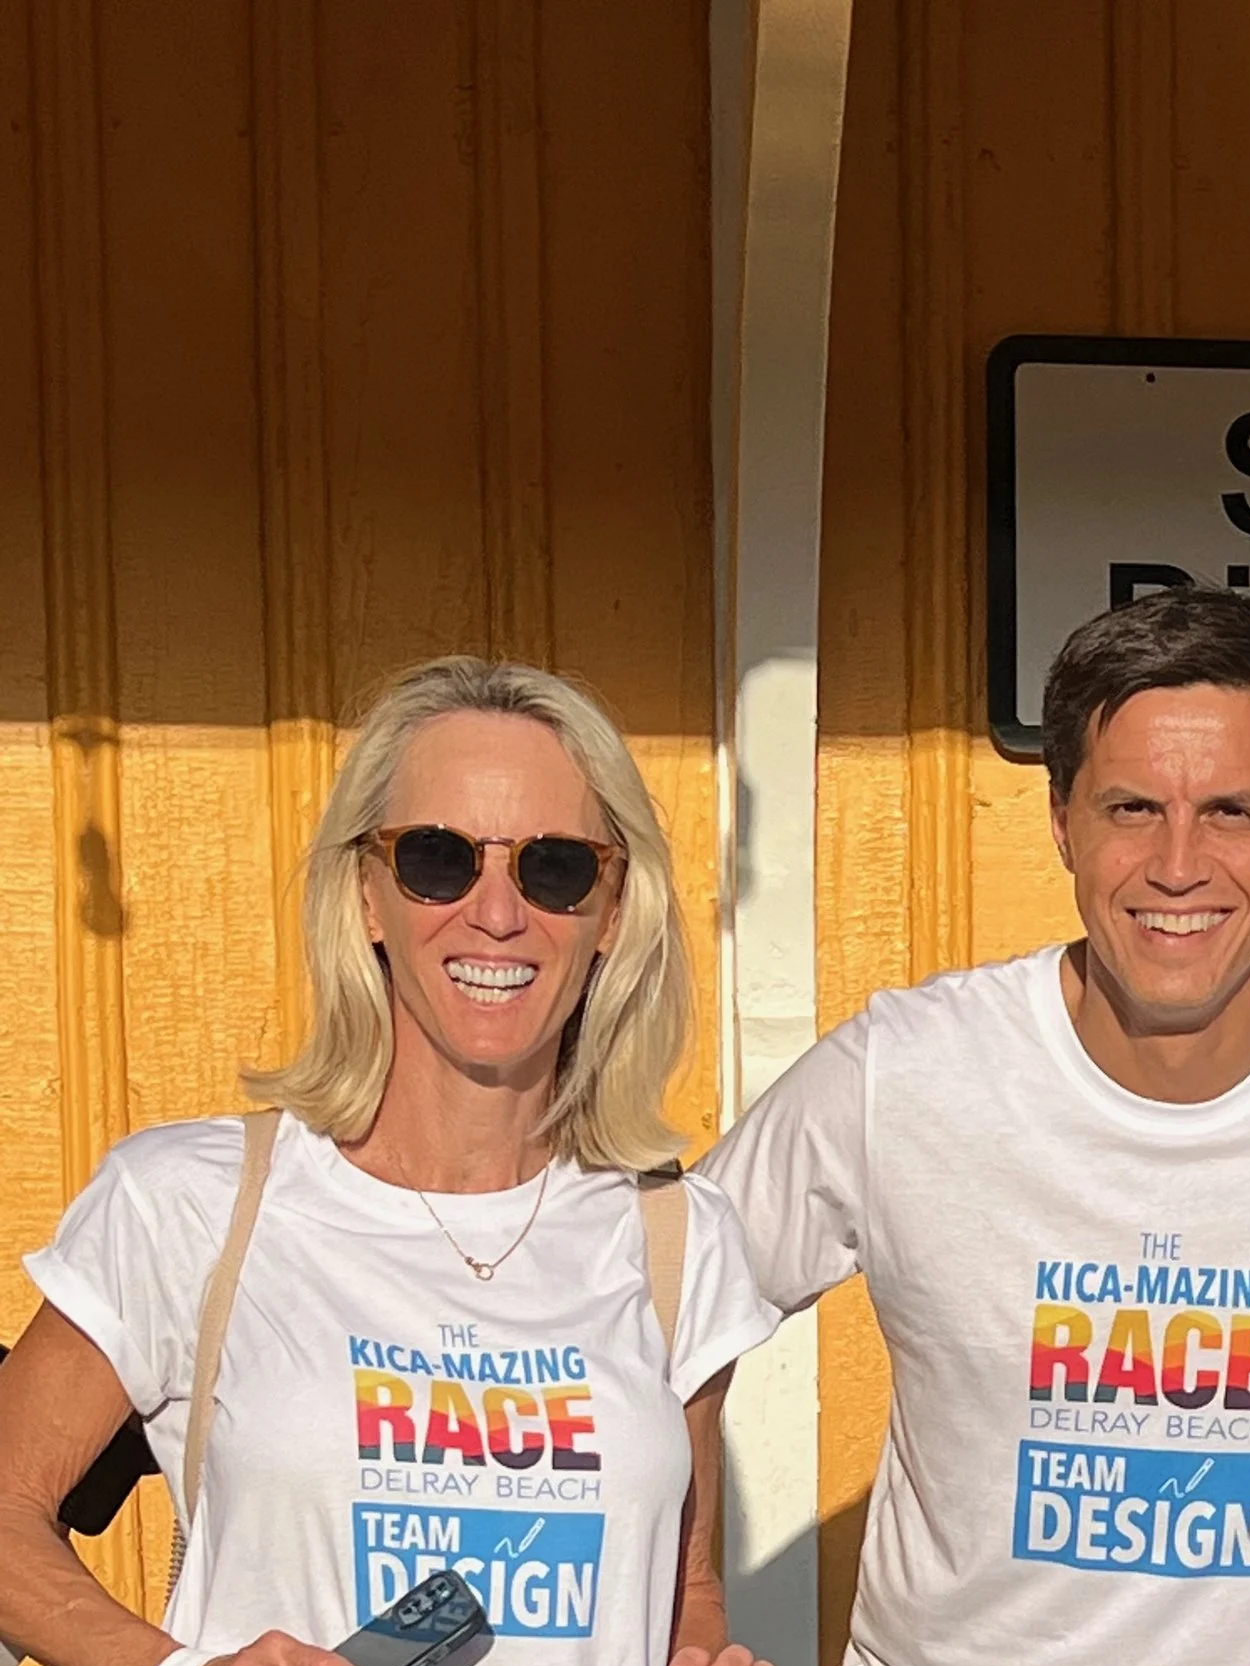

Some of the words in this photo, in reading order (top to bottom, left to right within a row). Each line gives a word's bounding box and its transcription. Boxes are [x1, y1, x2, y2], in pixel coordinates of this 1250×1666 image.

[1141, 1233, 1181, 1260] THE
[438, 1324, 480, 1347] THE
[349, 1335, 586, 1384] KICA-MAZING
[353, 1369, 602, 1471] RACE
[1030, 1408, 1150, 1436] DELRAY
[361, 1468, 479, 1495] DELRAY
[496, 1473, 600, 1500] BEACH
[1028, 1450, 1126, 1493] TEAM
[361, 1511, 461, 1552] TEAM
